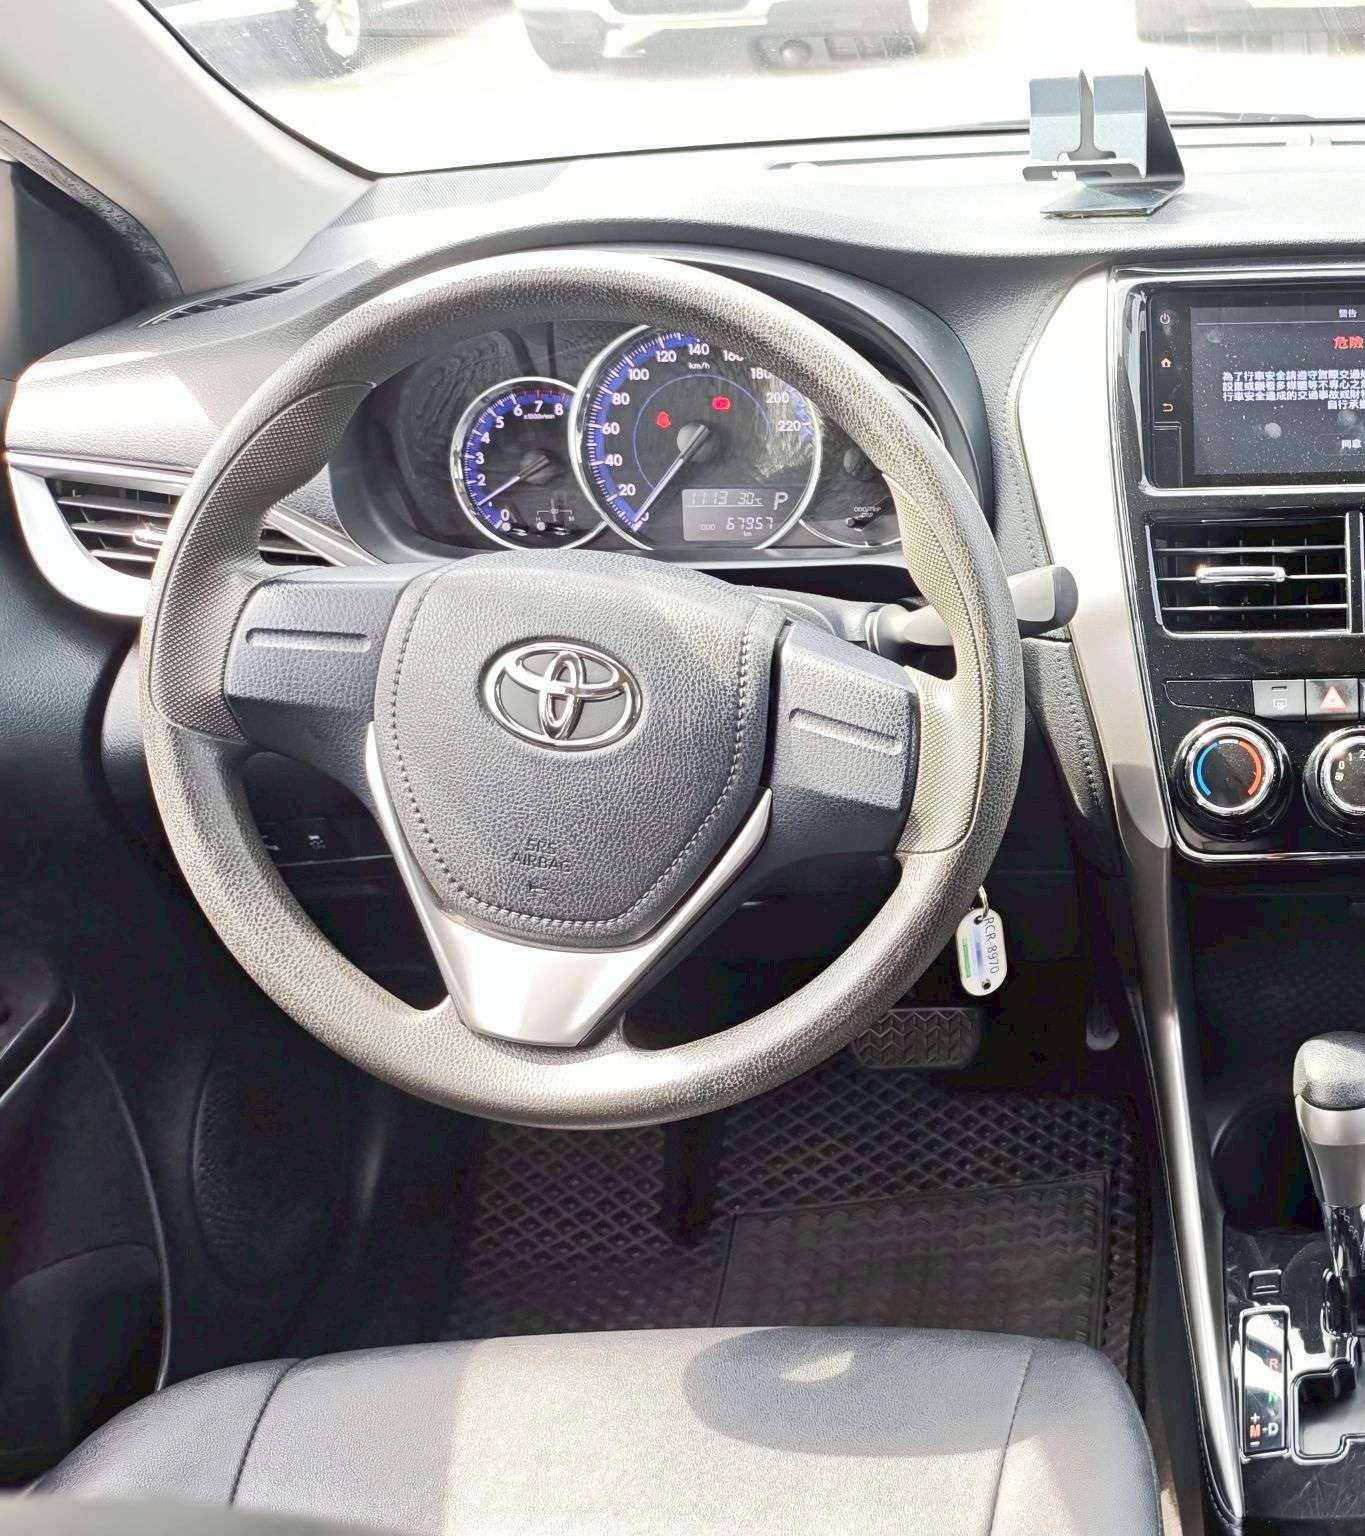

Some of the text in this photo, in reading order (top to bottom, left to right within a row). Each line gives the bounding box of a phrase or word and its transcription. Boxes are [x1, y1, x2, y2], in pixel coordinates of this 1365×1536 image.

[688, 343, 709, 356] 140
[1333, 336, 1364, 350] 危險
[656, 350, 676, 363] 120
[688, 361, 710, 370] km/h
[628, 368, 649, 381] 100
[612, 393, 630, 405] 80
[766, 392, 789, 404] 200
[513, 405, 523, 417] 6
[534, 400, 543, 412] 7
[554, 403, 563, 415] 8
[495, 416, 505, 428] 5
[602, 422, 620, 435] 60
[777, 421, 801, 432] 220
[480, 432, 491, 444] 4
[475, 452, 485, 464] 3
[605, 454, 623, 466] 40
[477, 474, 486, 486] 2
[618, 483, 636, 496] 20
[773, 491, 789, 511] P
[500, 508, 510, 521] 0
[726, 516, 774, 530] 67957
[1338, 760, 1345, 770] 0
[1347, 752, 1353, 762] 1
[1358, 749, 1365, 759] 2
[511, 850, 573, 873] AIRBAG
[983, 915, 1000, 975] RCR-8970
[1268, 1358, 1279, 1371] R
[1249, 1422, 1279, 1439] M D
